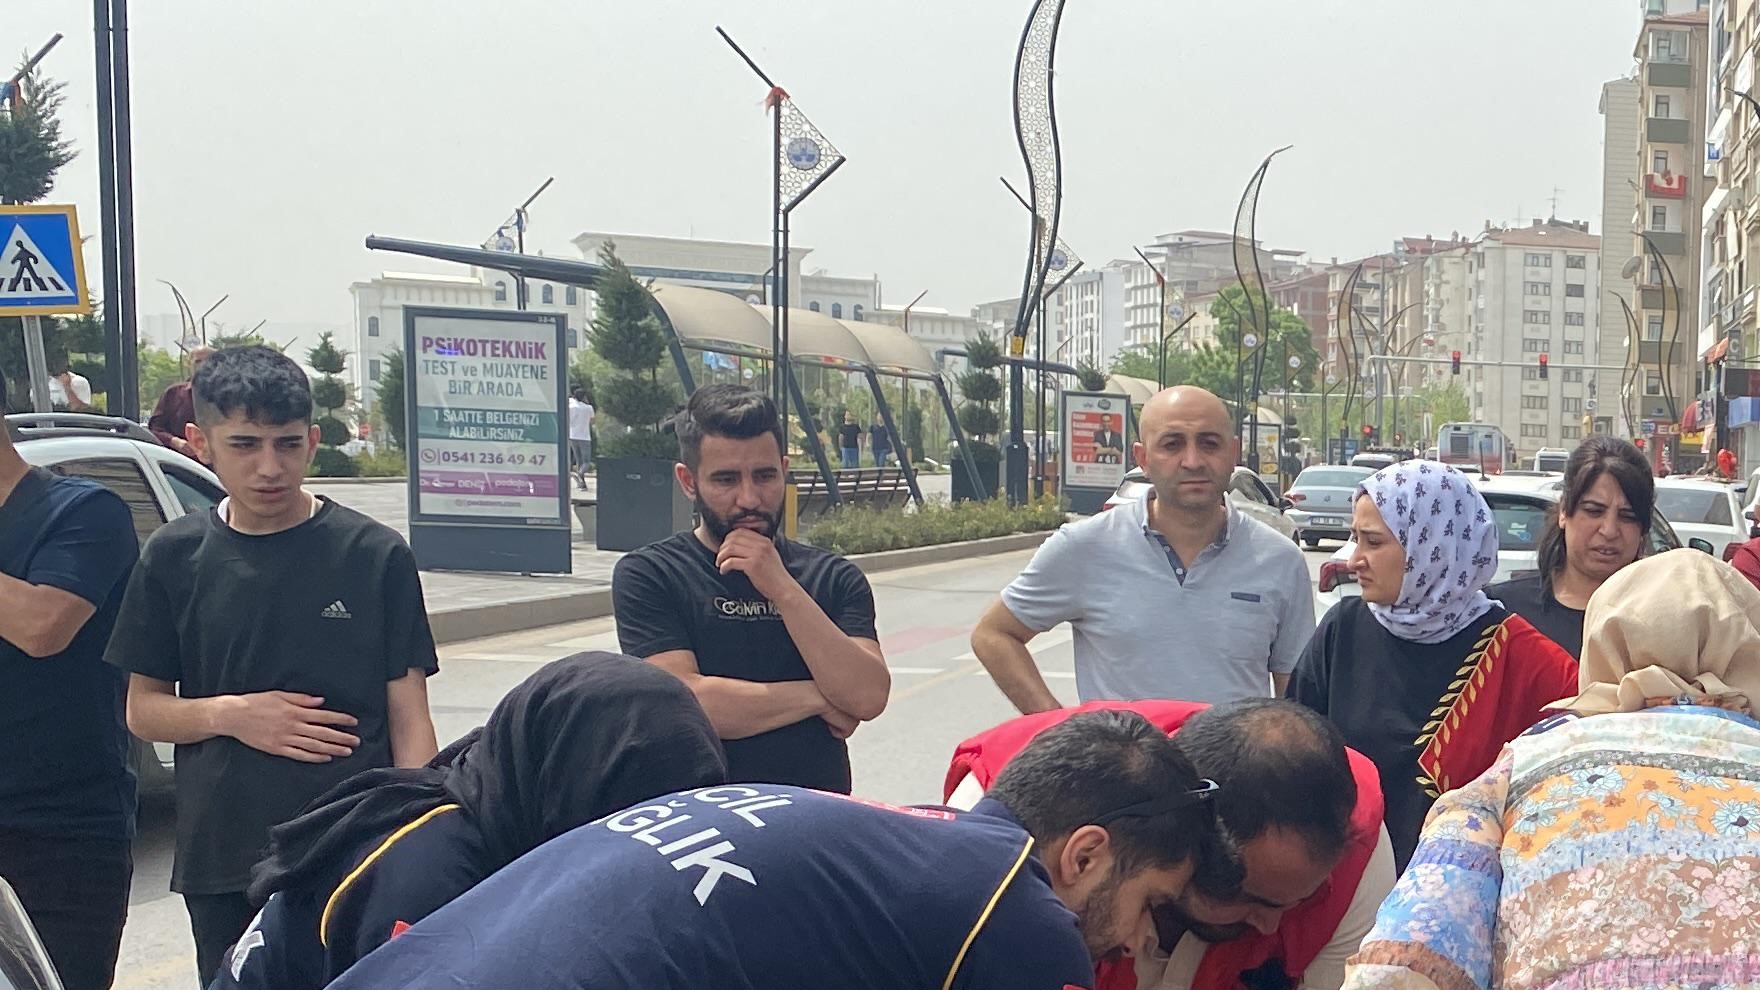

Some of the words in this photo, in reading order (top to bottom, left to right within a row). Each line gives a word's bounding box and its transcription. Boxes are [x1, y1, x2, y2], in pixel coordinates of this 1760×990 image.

[423, 360, 457, 376] TEST
[462, 365, 478, 377] ve
[482, 363, 548, 380] MUAYENE
[476, 381, 524, 397] ARADA
[434, 410, 439, 421] 1
[443, 410, 483, 424] SAATTE
[442, 451, 475, 463] 0541
[479, 452, 503, 464] 236
[507, 454, 525, 465] 49
[528, 454, 546, 467] 47
[678, 786, 793, 829] CİL
